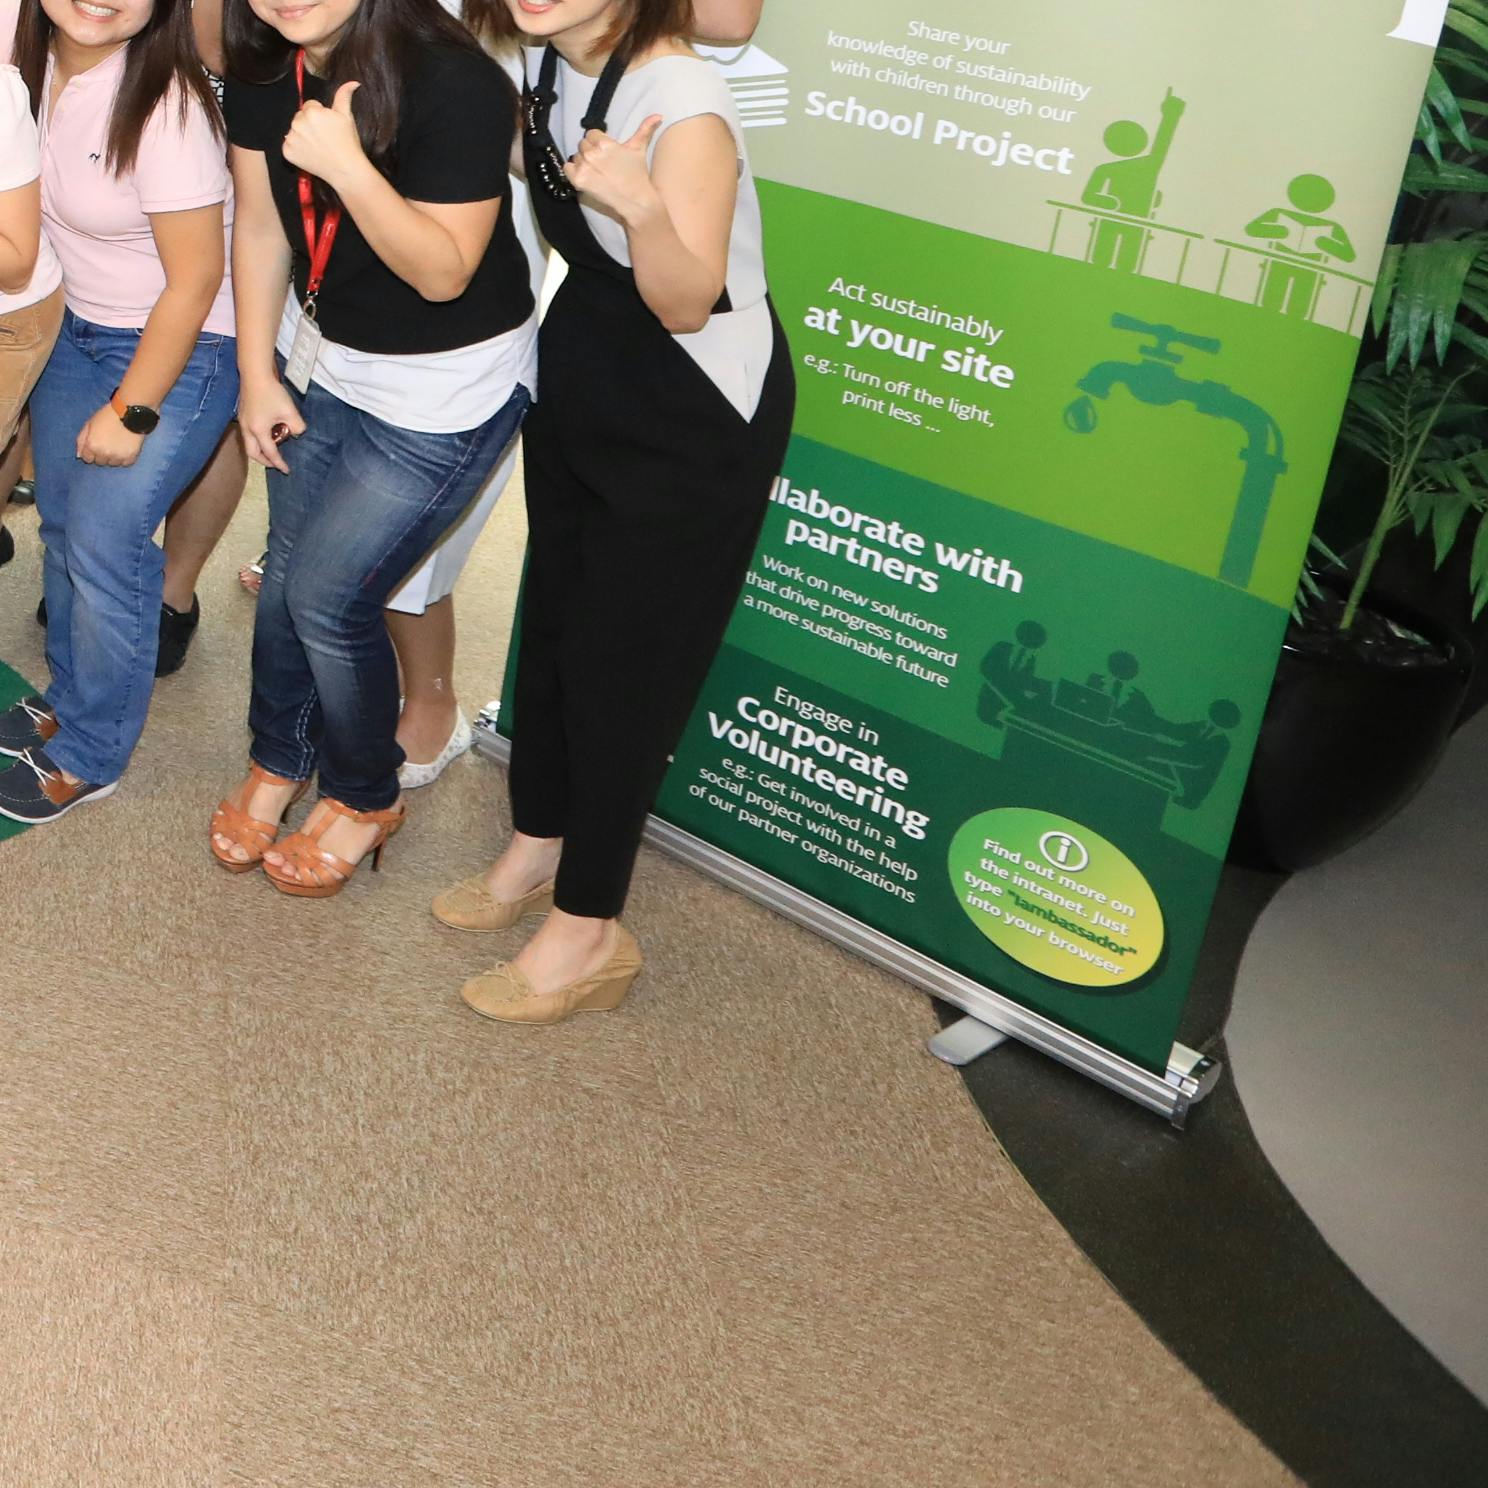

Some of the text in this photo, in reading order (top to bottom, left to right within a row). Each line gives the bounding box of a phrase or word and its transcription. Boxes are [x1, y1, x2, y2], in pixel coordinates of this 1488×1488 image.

[827, 30, 1092, 102] knowledge of sustainability
[908, 20, 1012, 56] Share your
[830, 59, 1077, 123] with children through our
[805, 90, 1075, 176] School Project
[804, 306, 1015, 389] at your site
[828, 277, 1004, 346] Act sustainably
[804, 354, 995, 427] e.g.: Turn off the light,
[842, 390, 885, 414] print
[888, 402, 922, 426] less
[785, 519, 939, 593] partners
[934, 542, 1023, 593] with
[745, 571, 958, 667] that drive progress toward
[763, 554, 948, 640] Work on new solutions
[743, 594, 950, 688] a more sustainable future
[737, 696, 909, 791] Corporate
[774, 686, 880, 746] Engage in
[707, 711, 931, 841] Volunteering
[722, 757, 896, 849] e.g.: Get involved in a
[688, 783, 917, 904] of our partner organizations
[699, 768, 919, 882] social project with the help
[964, 871, 1003, 896] type
[980, 857, 1130, 936] the intranet. Just
[983, 838, 1136, 918] Find out more on
[966, 891, 1124, 975] into your browser
